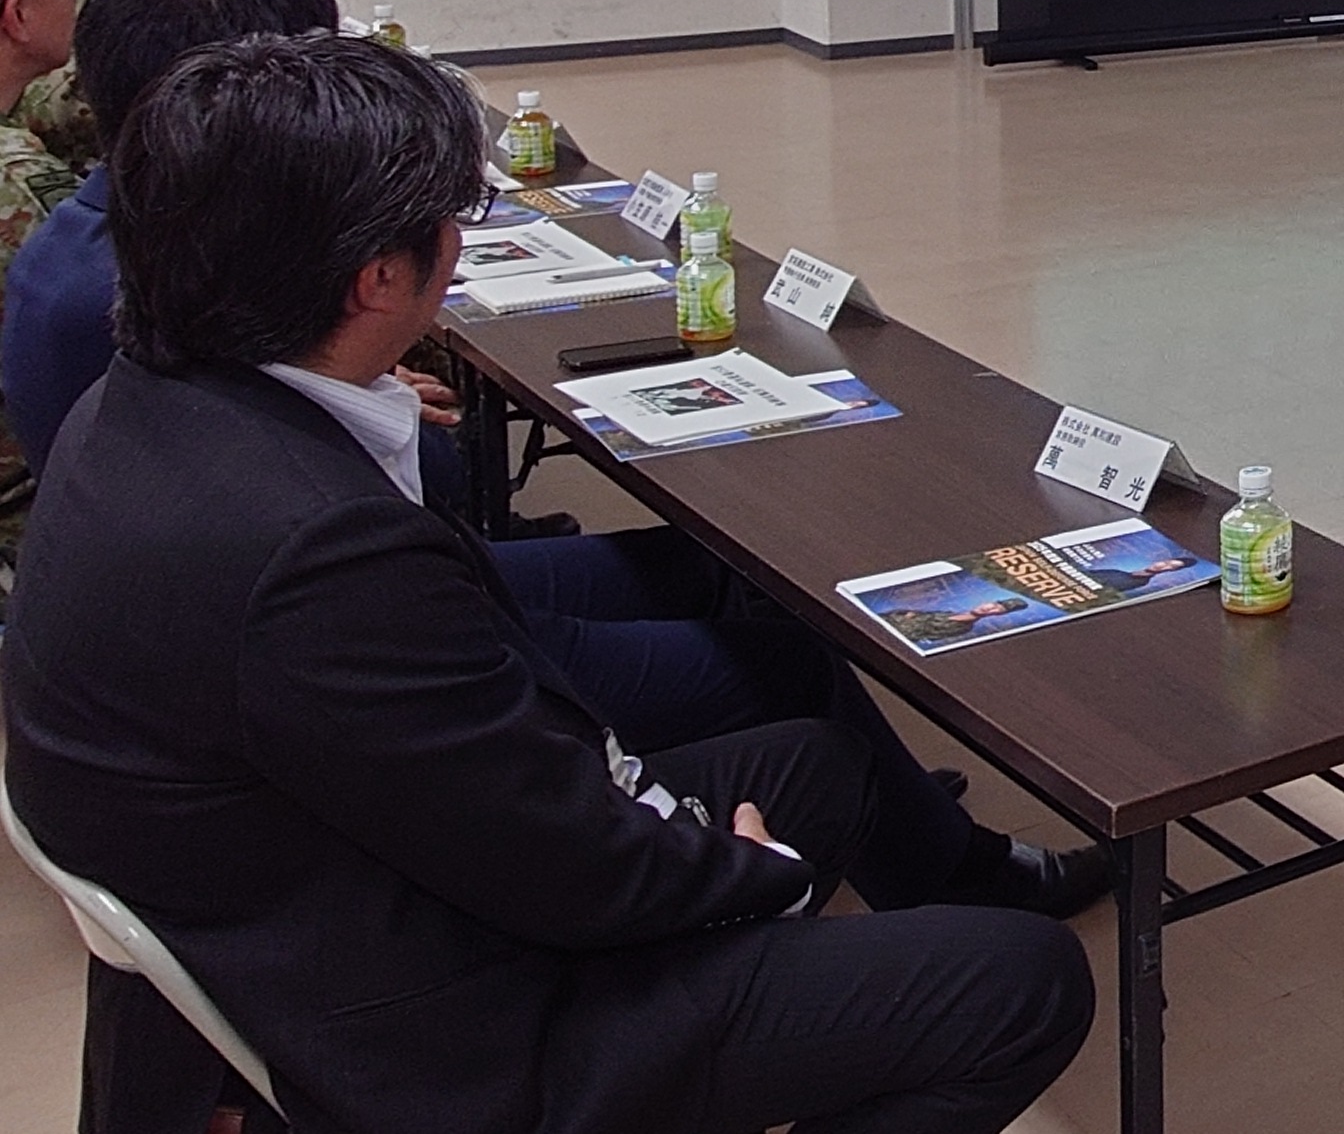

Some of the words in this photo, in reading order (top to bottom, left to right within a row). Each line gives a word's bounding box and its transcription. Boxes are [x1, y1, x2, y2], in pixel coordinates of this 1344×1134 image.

[1061, 416, 1089, 435] 株式会社
[985, 547, 1085, 608] RESERVE
